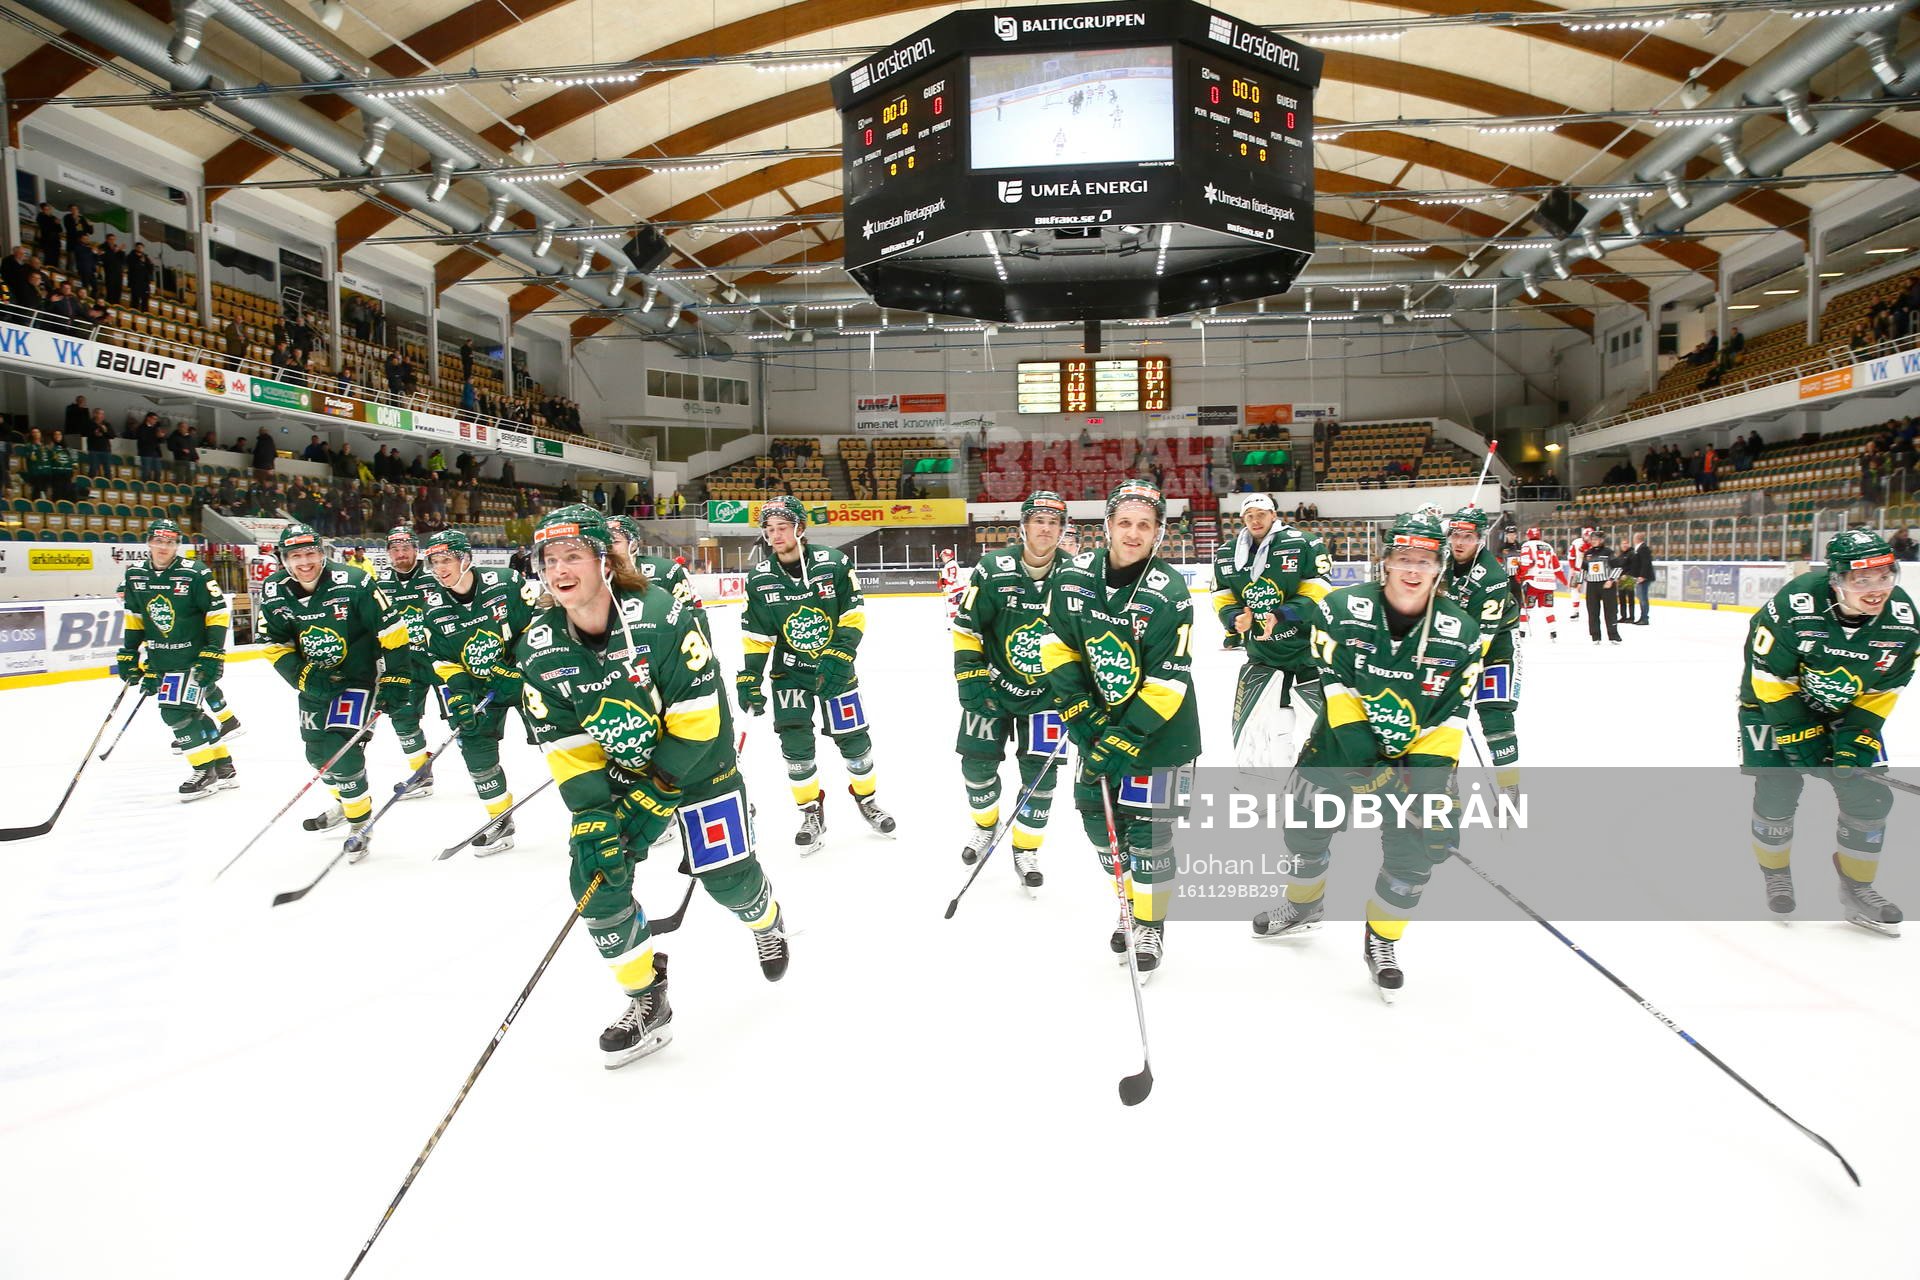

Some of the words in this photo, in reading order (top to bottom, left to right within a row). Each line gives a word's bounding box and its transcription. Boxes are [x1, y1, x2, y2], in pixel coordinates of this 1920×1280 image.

[1022, 13, 1145, 32] BALTICGRUPPEN
[923, 80, 946, 99] GUEST
[1276, 94, 1298, 110] GUEST
[1031, 180, 1081, 197] UMEÅ
[1086, 180, 1148, 195] ENERGI
[1218, 189, 1250, 209] Umestan
[1251, 198, 1295, 221] företagspark
[873, 215, 903, 233] Umestan
[903, 197, 946, 224] företagspark
[0, 326, 31, 356] VK
[53, 337, 84, 367] VK
[96, 348, 175, 380] BAUER
[1871, 360, 1888, 381] VK
[857, 420, 898, 429] ume.net
[828, 503, 884, 522] påsen
[1706, 568, 1731, 585] Hotel
[784, 591, 813, 601] VOLVO
[460, 615, 488, 628] VOLVO
[1090, 609, 1130, 626] VOLVO
[11, 628, 36, 642] OSS
[1823, 645, 1870, 661] VOLVO
[1368, 665, 1414, 681] VOLVO
[777, 689, 807, 709] VK
[586, 712, 648, 744] Björk
[965, 711, 998, 740] VK
[1496, 745, 1516, 757] INAB
[478, 780, 498, 791] INAB
[972, 791, 996, 803] INAB
[1141, 857, 1170, 870] INAB
